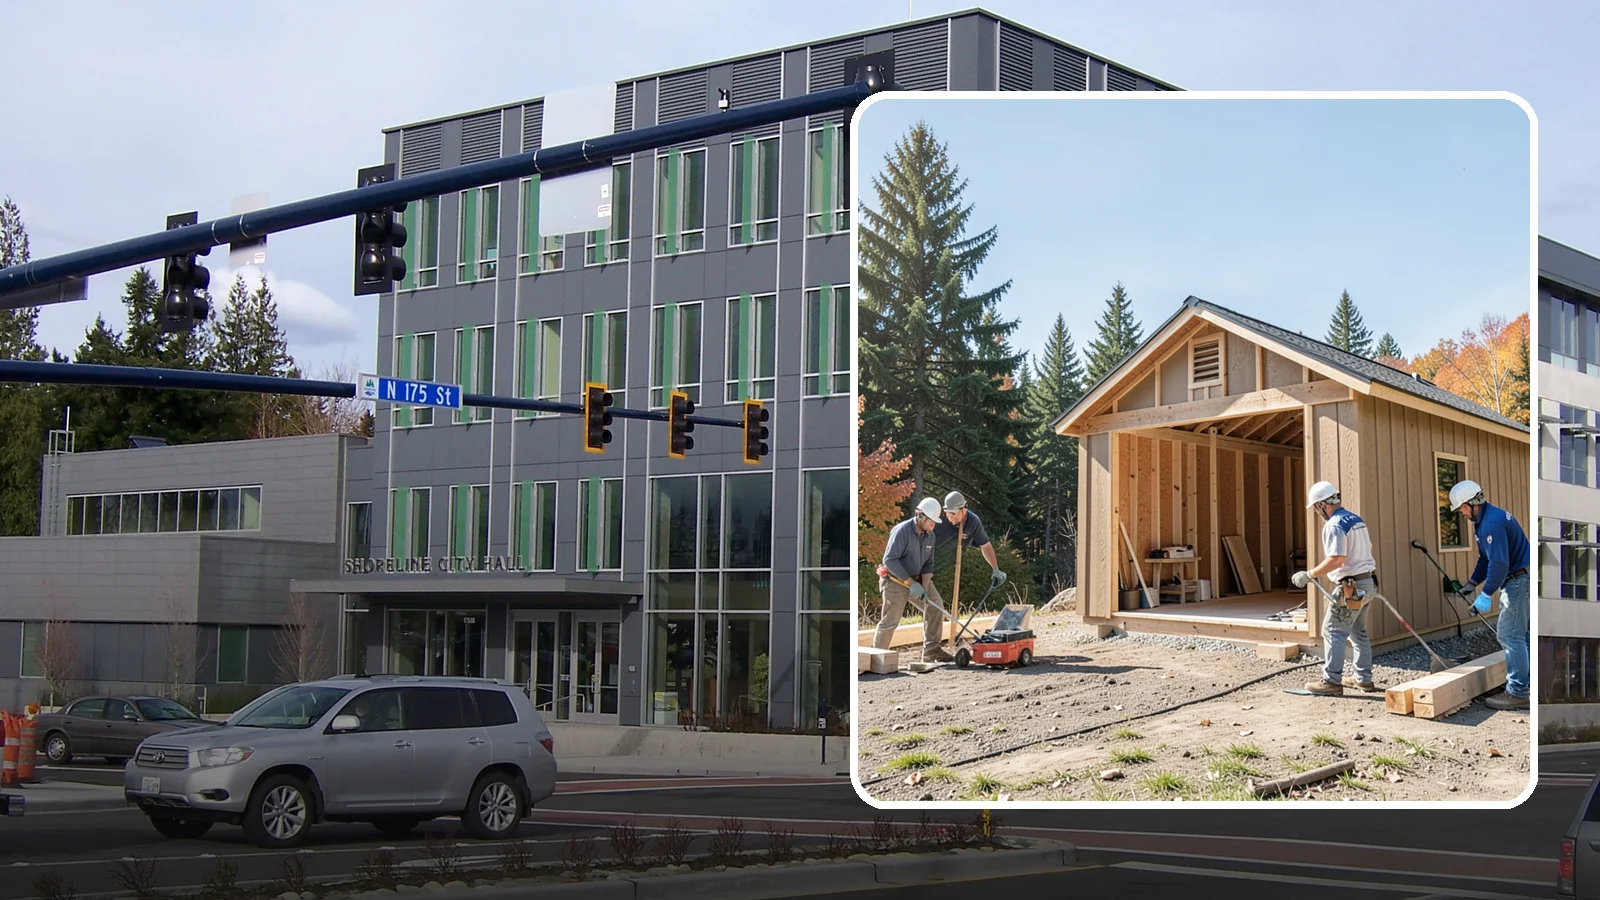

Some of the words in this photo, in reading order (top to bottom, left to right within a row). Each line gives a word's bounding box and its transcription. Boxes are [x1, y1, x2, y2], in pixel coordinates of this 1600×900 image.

[387, 380, 396, 400] N
[405, 382, 427, 403] 175
[436, 386, 451, 406] St
[344, 556, 431, 574] SHORELINE
[438, 556, 475, 572] CITY
[484, 555, 526, 571] HALL
